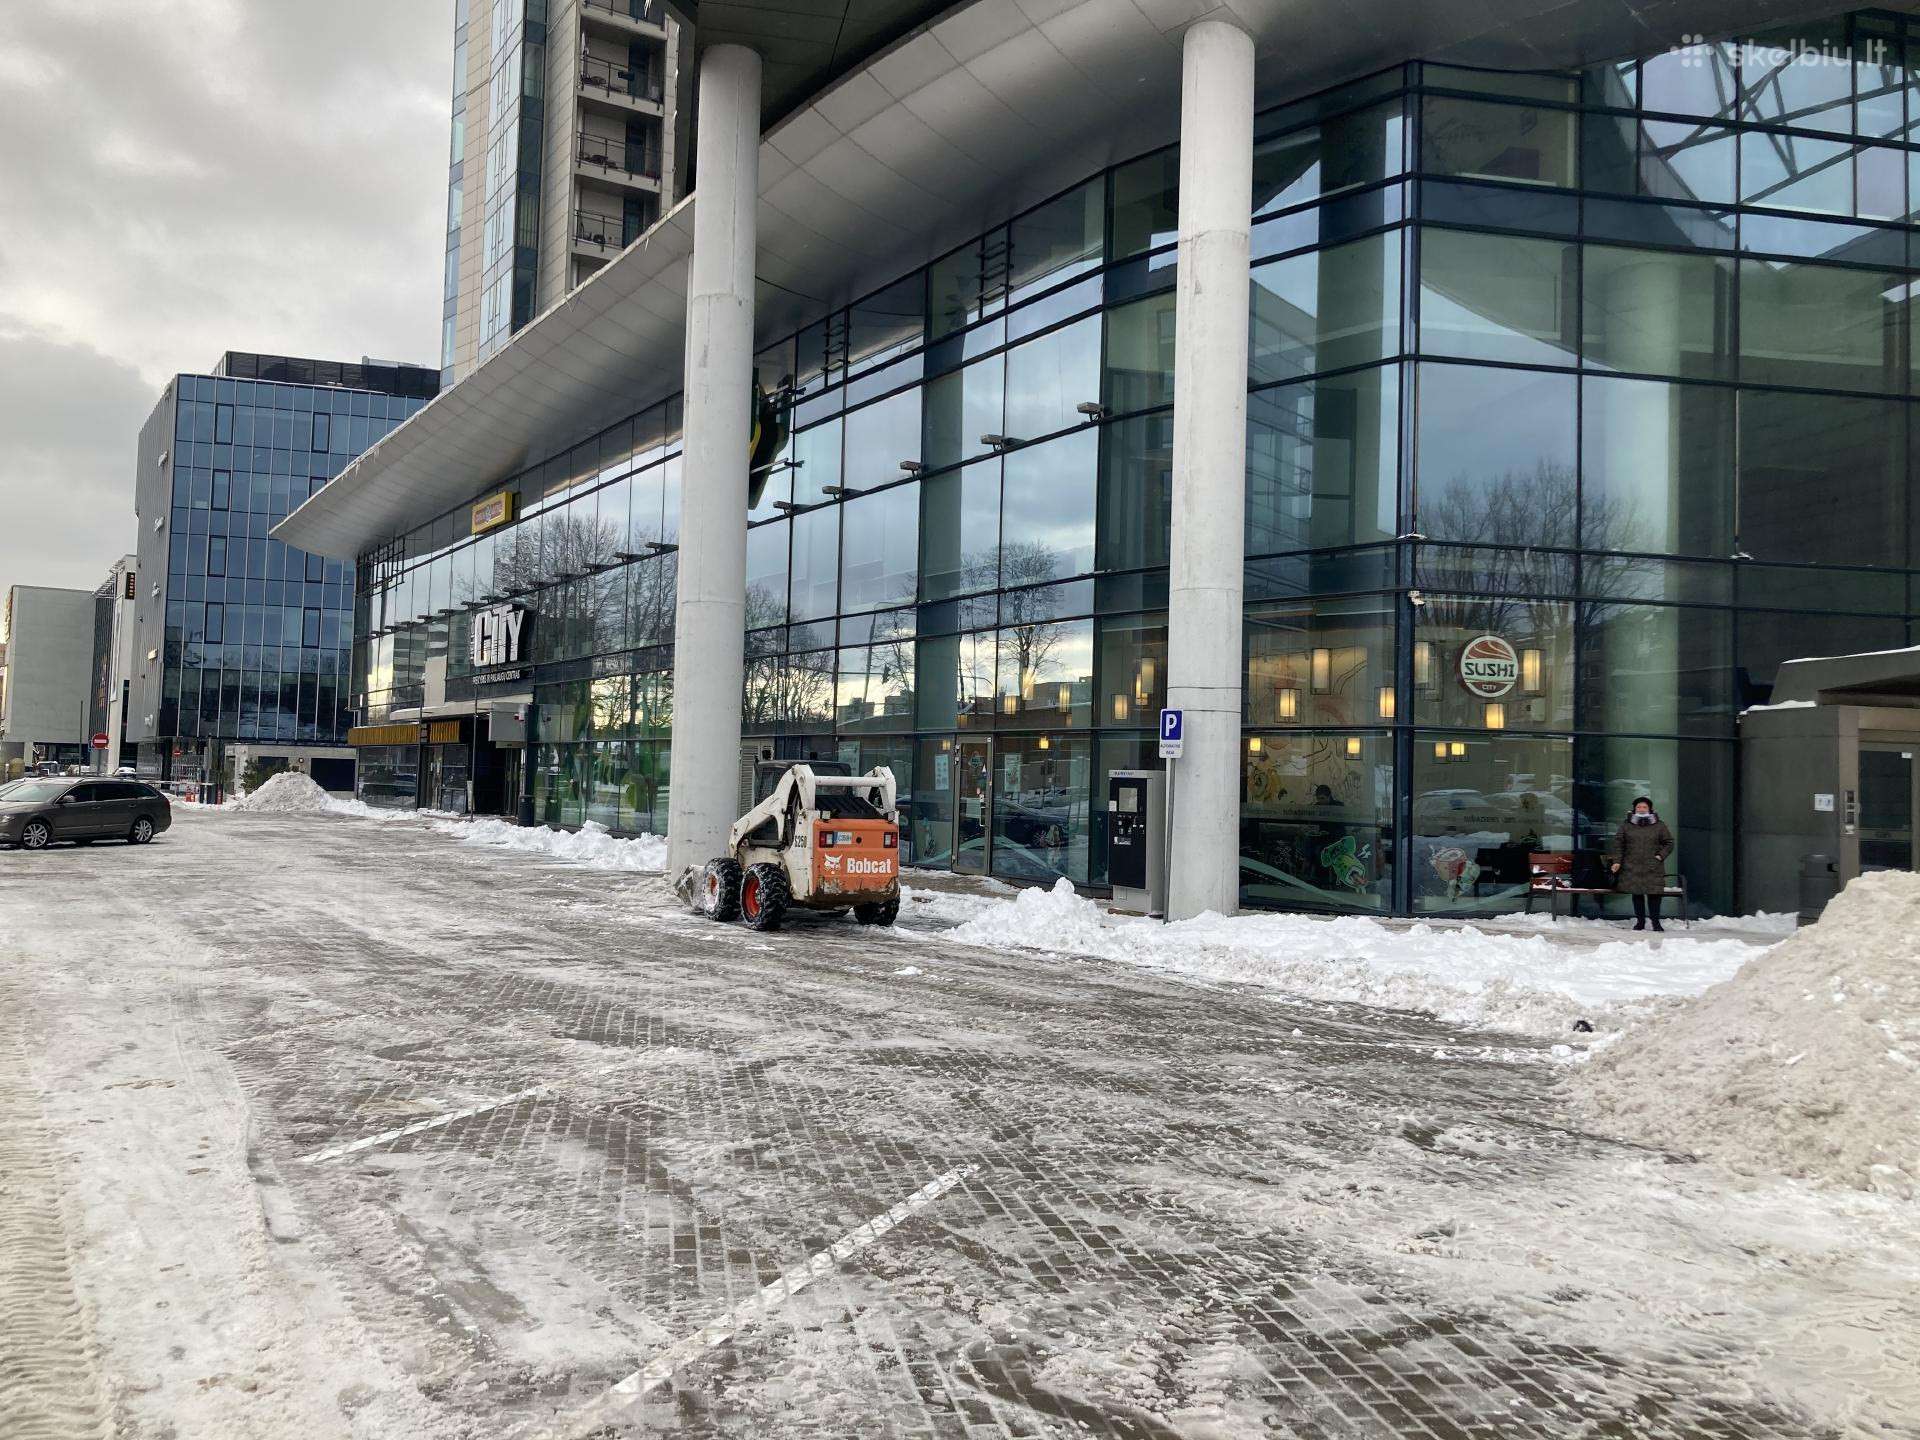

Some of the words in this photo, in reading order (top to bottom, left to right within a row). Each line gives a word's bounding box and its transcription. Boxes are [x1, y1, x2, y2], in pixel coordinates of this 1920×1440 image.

[473, 604, 525, 667] CITY
[1464, 661, 1515, 678] SUSHI
[1165, 713, 1178, 737] P
[846, 857, 892, 874] Bobcat
